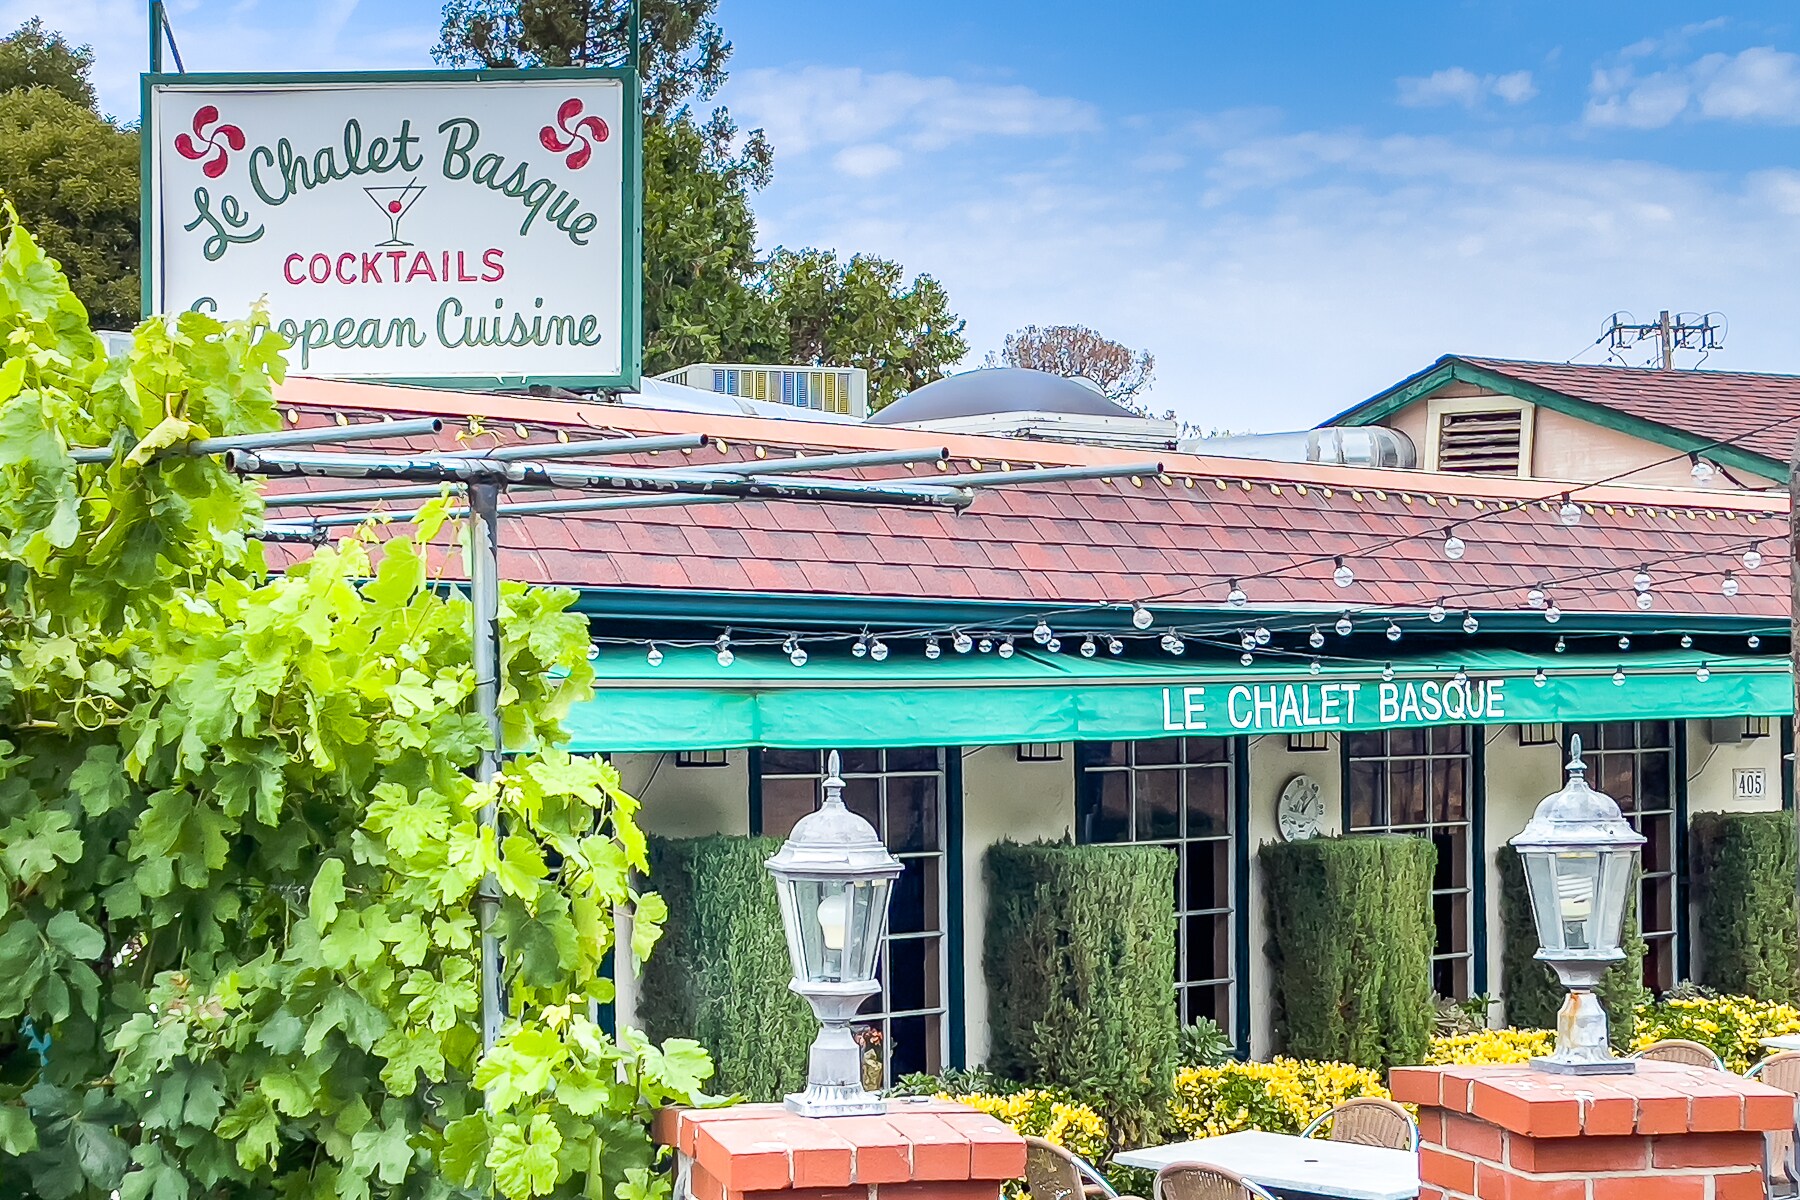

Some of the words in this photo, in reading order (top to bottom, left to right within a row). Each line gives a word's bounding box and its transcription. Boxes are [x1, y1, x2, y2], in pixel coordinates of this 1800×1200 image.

[184, 186, 265, 261] Le
[249, 118, 423, 206] Chalet
[438, 117, 597, 246] Basque
[284, 248, 504, 285] COCKTAILS
[178, 296, 427, 370] opean
[437, 297, 601, 349] Cuisine
[1162, 686, 1207, 731] LE
[1228, 683, 1361, 729] CHALET
[1379, 679, 1506, 723] BASQUE
[1739, 774, 1762, 794] 405
